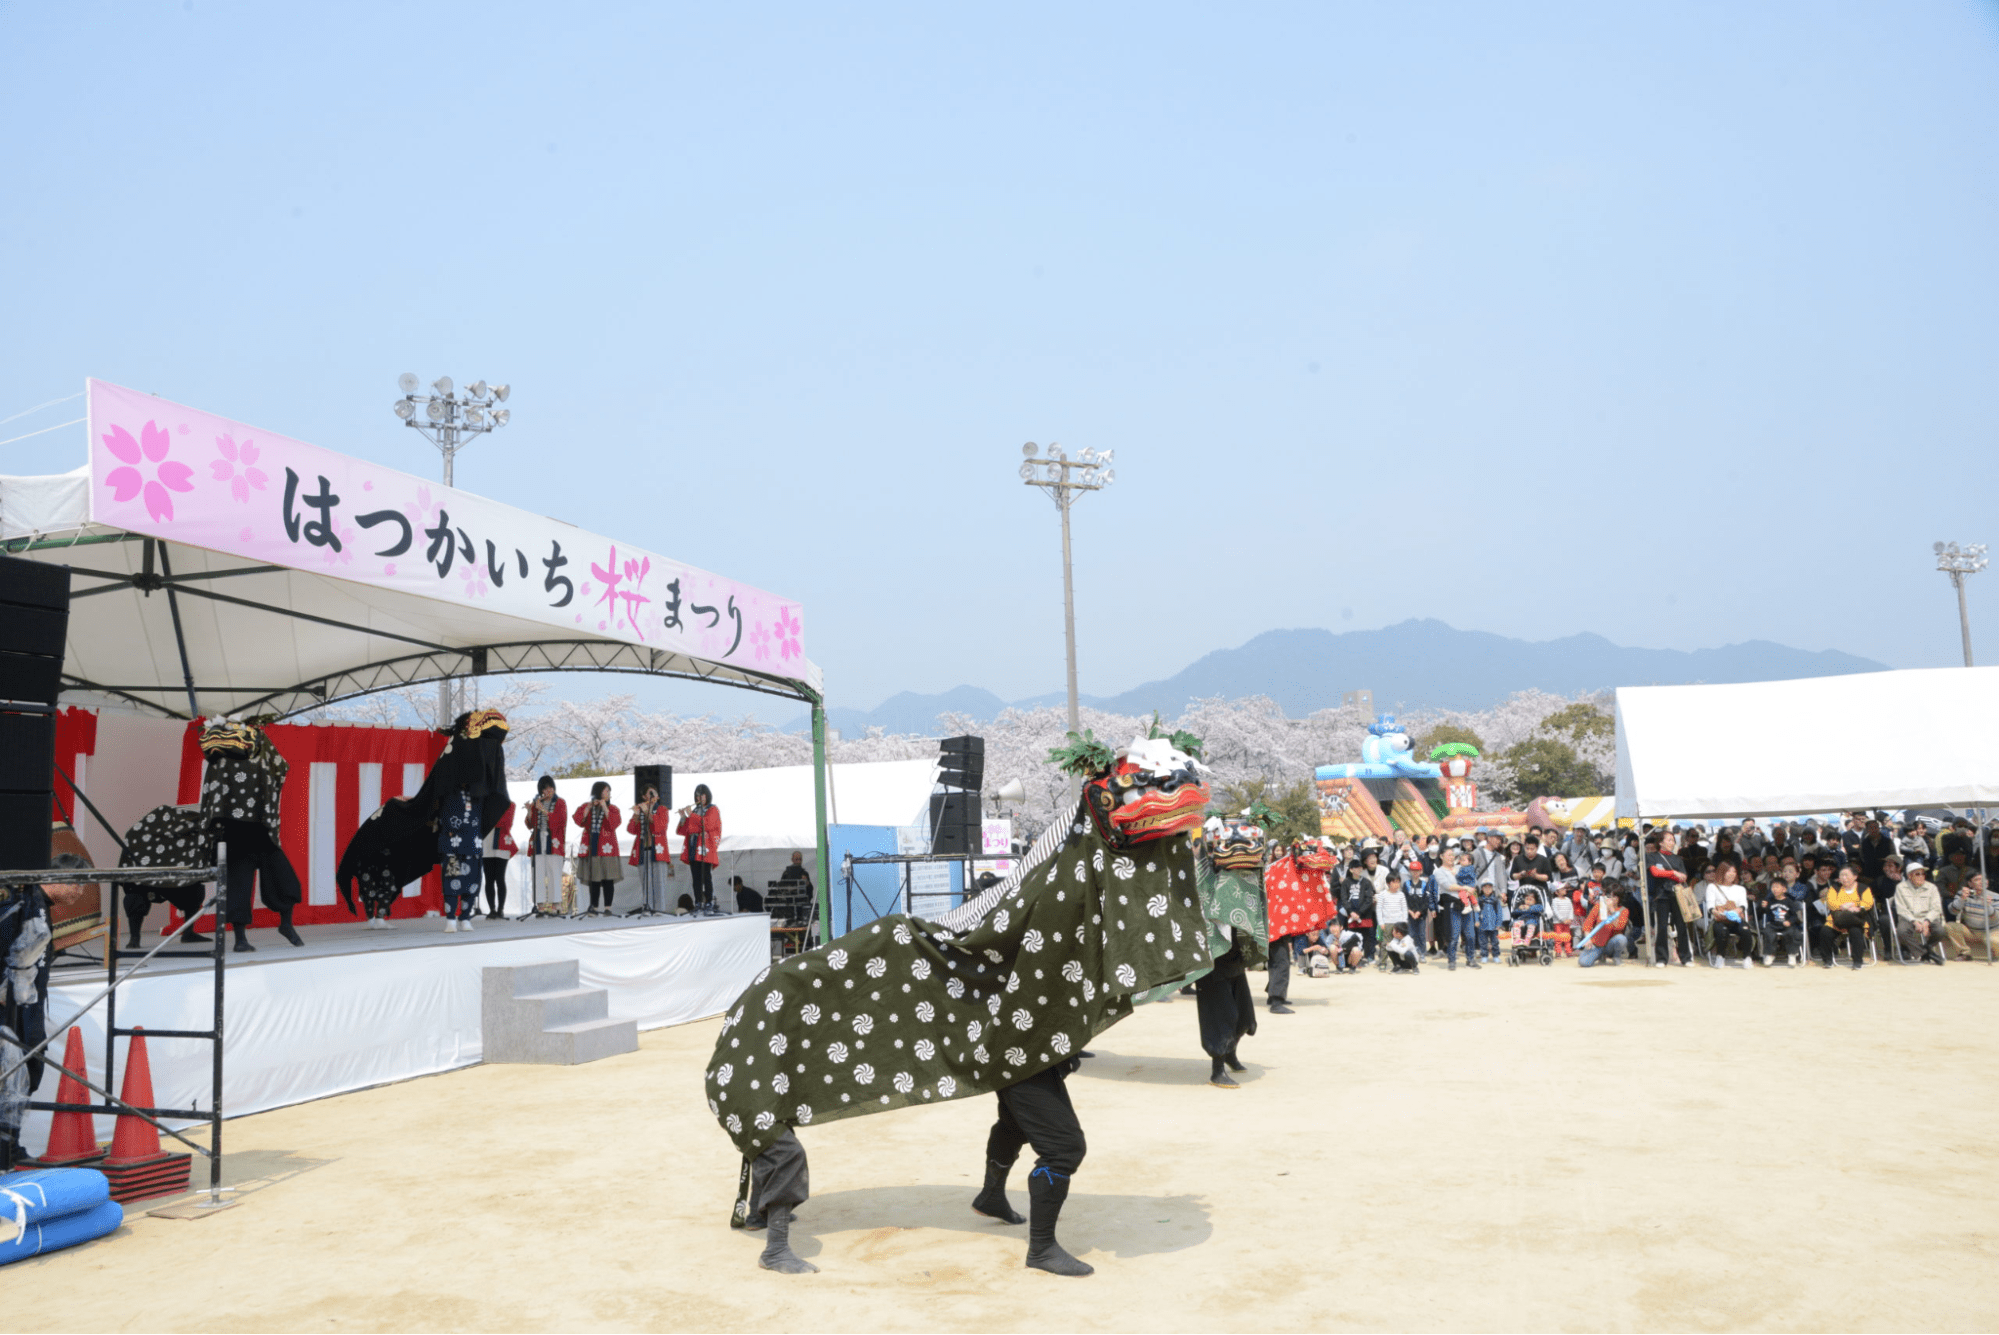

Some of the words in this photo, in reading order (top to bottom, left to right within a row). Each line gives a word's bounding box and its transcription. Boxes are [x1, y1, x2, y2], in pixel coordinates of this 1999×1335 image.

[283, 466, 743, 658] はつかいち桜まつり
